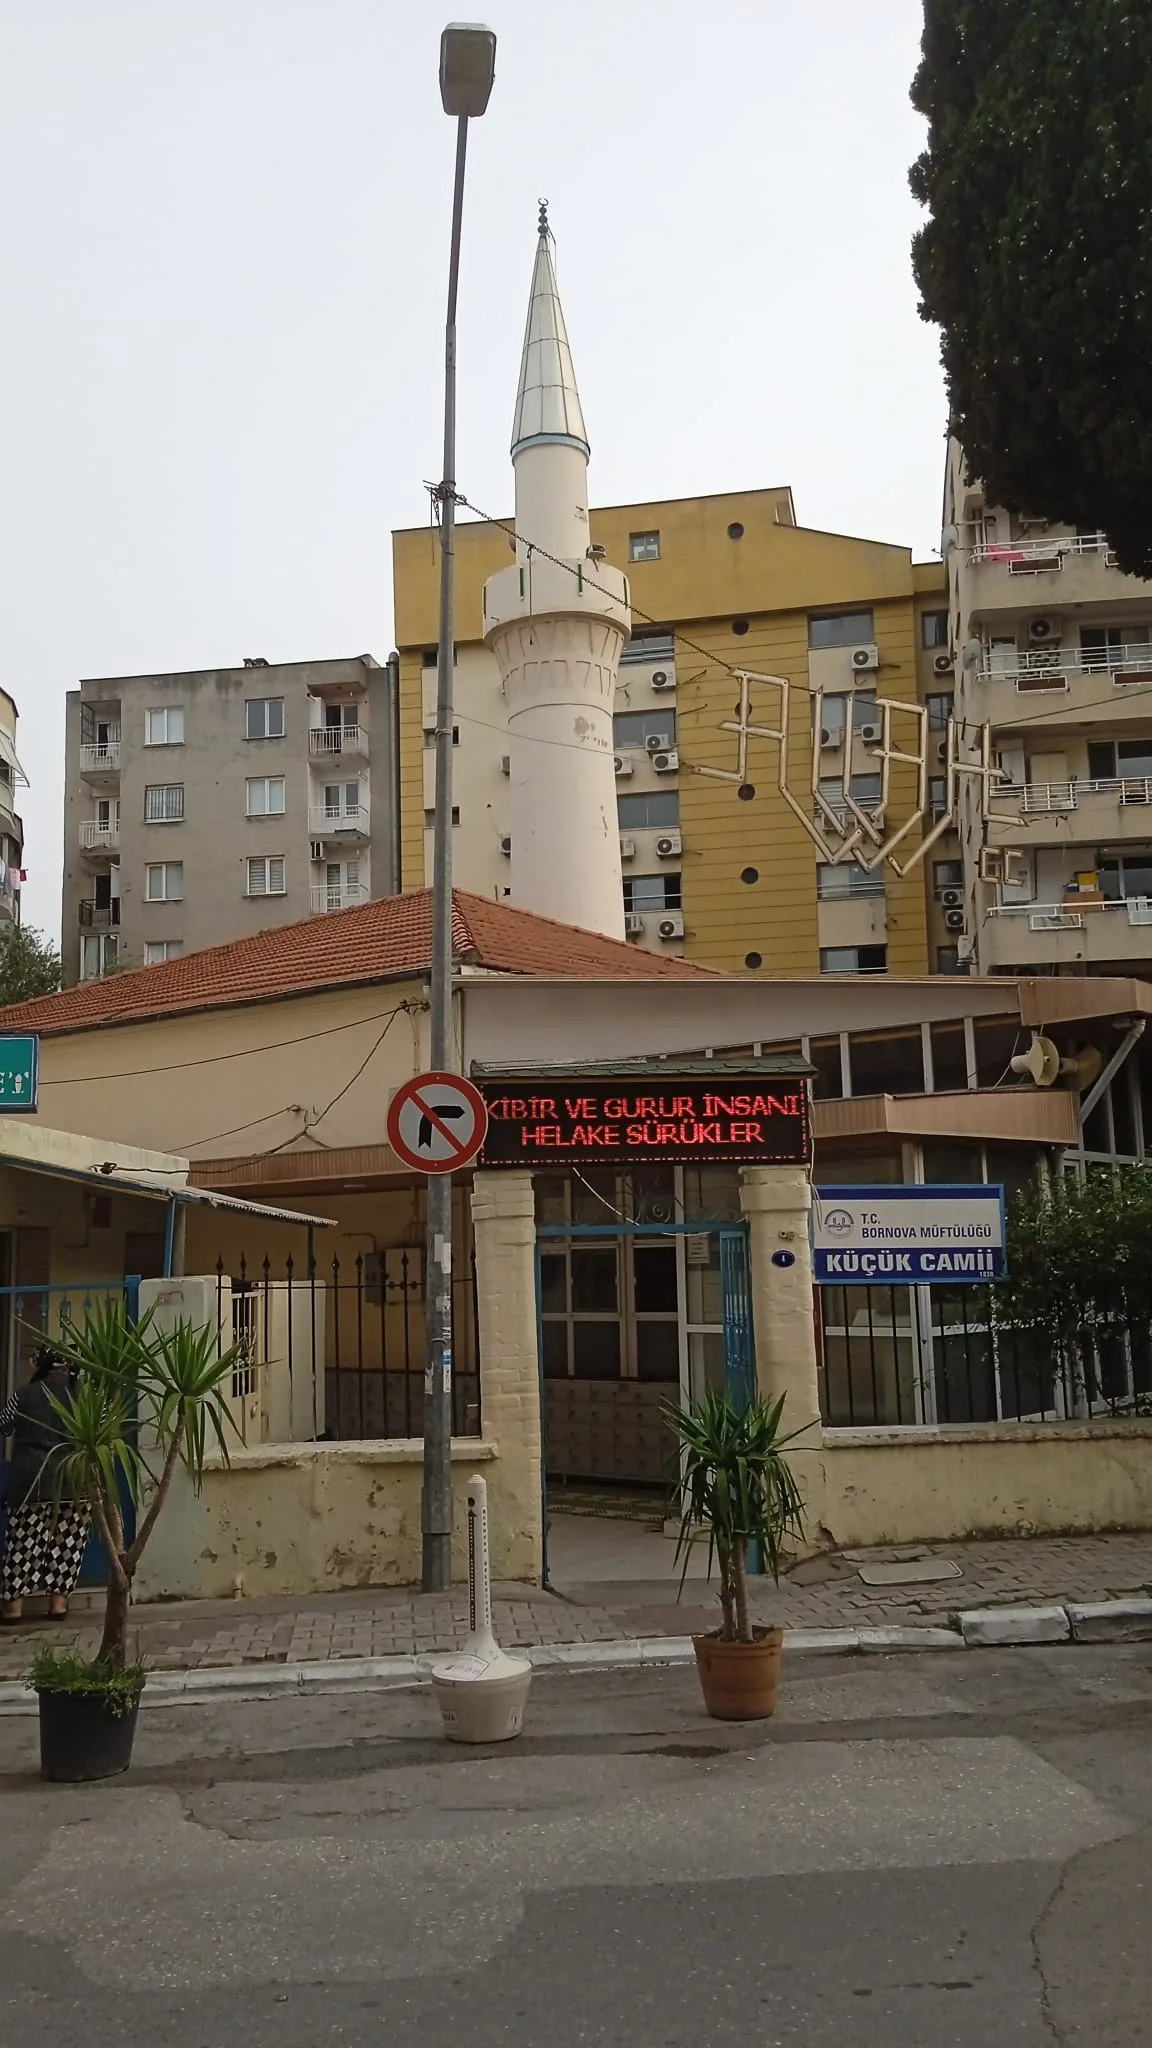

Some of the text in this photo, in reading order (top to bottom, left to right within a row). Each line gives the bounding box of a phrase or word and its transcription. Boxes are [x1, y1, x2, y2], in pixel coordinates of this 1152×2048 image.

[485, 1093, 801, 1120] KİBİR VE GURUR İNSANI
[521, 1120, 766, 1146] HELAKE SÜRÜKLER
[860, 1213, 881, 1225] T.C.
[862, 1224, 992, 1239] BORNOVA MÜFTÜLÜĞÜ
[826, 1249, 994, 1276] KÜÇÜK CAMİİ
